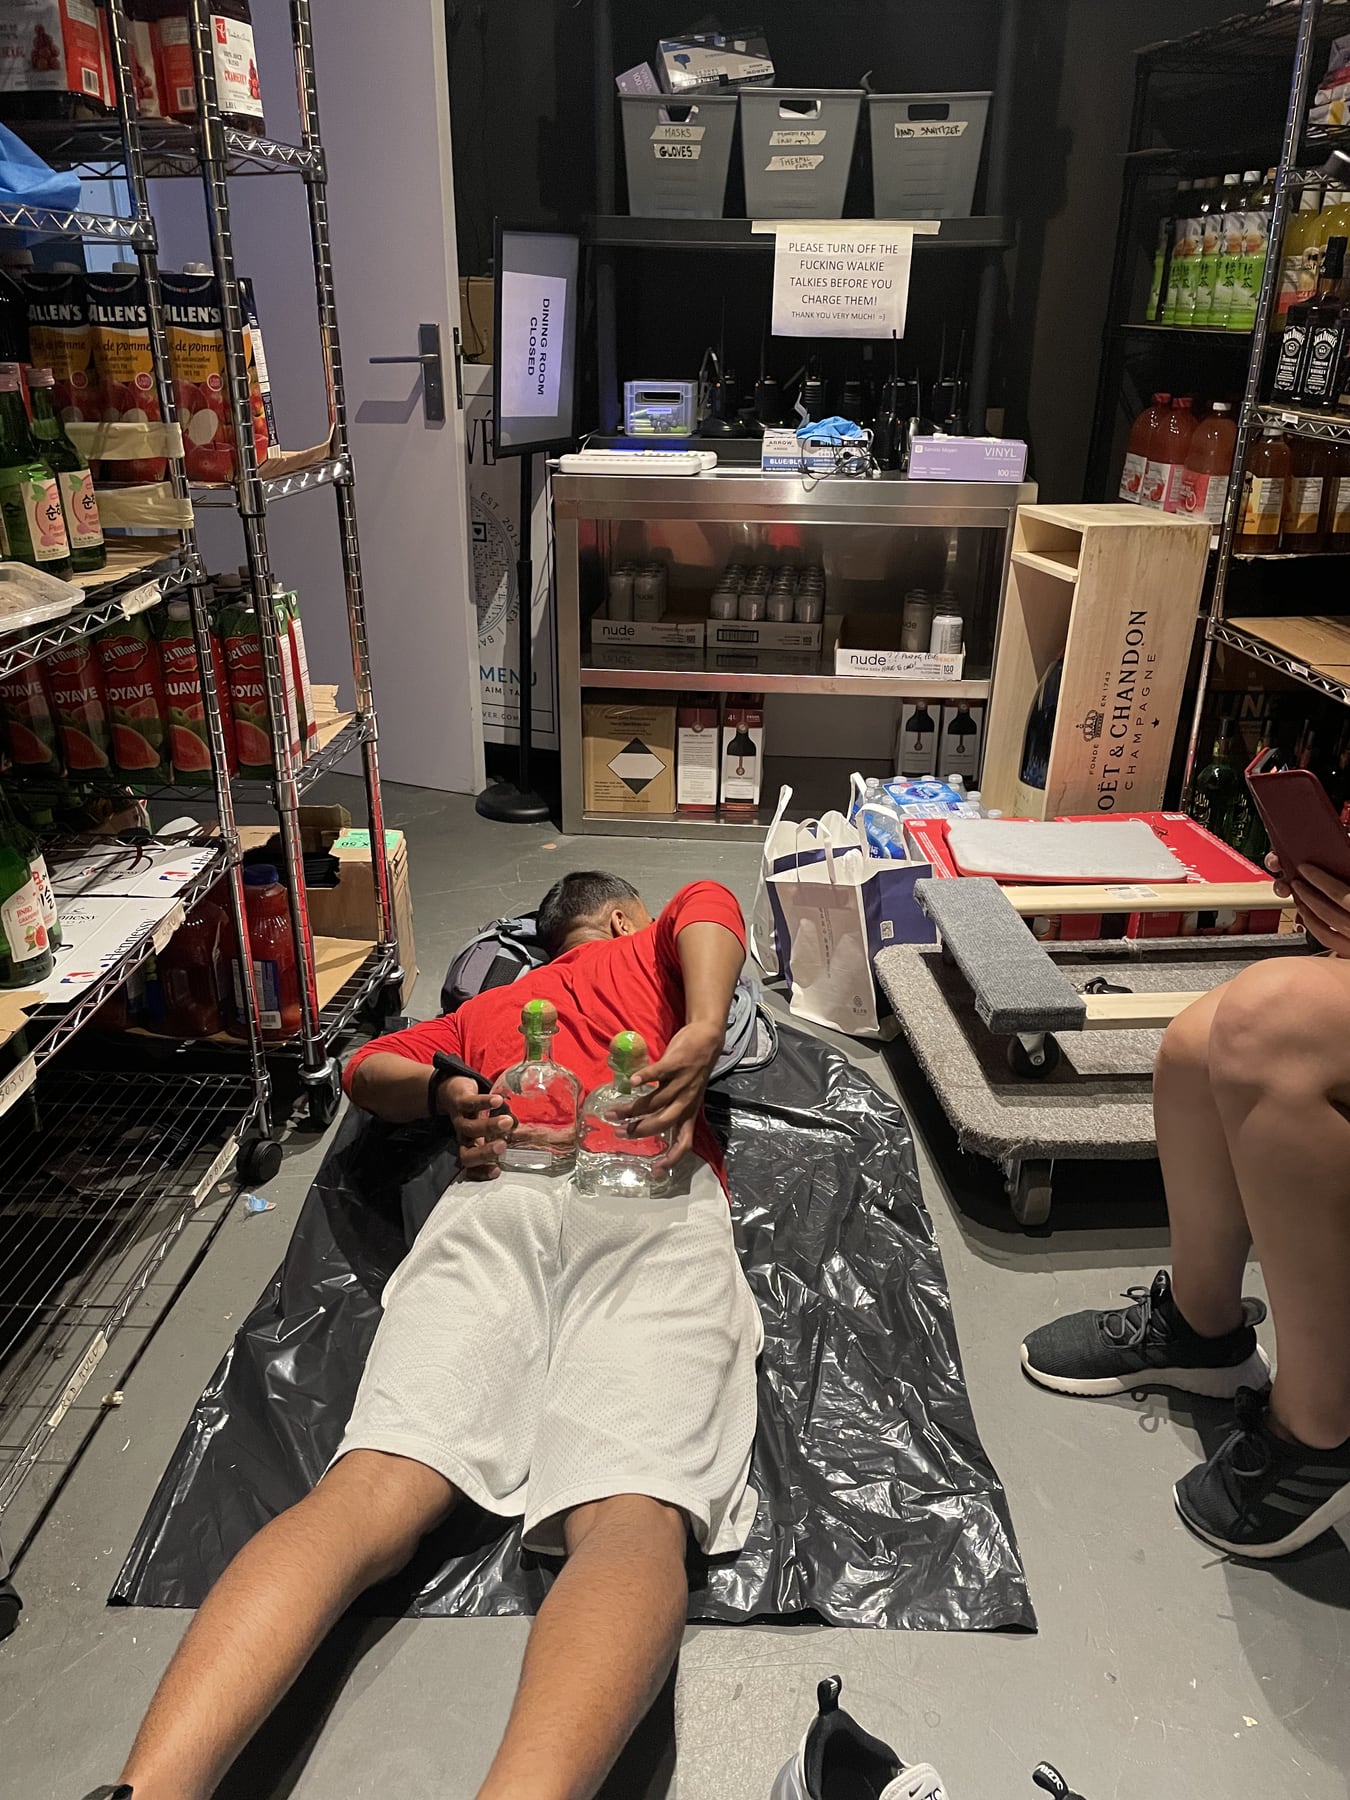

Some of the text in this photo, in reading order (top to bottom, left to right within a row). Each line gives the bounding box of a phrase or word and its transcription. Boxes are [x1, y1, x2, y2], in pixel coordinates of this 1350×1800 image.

[664, 127, 692, 138] MASKS
[659, 145, 693, 158] GLOVES
[788, 242, 899, 255] PLEASE TURN OFF THE
[800, 260, 885, 271] FUCKING WALKIE
[790, 277, 893, 289] TALKIES BEFORE YOU
[801, 294, 878, 306] CHARGE THEM!
[28, 304, 83, 321] ALLEN'S
[88, 305, 148, 322] ALLEN'S
[162, 304, 221, 323] ALLEN'S
[792, 311, 815, 319] THANK
[816, 311, 831, 319] YOU
[832, 312, 850, 320] VERY
[850, 312, 875, 320] MUCH!
[103, 338, 152, 356] de pomme
[175, 339, 225, 356] de pomme
[528, 317, 538, 376] CLOSED
[537, 298, 550, 395] DINING ROOM
[984, 447, 1017, 458] VINYL
[480, 491, 499, 511] EST
[602, 624, 635, 636] nude
[116, 642, 145, 657] Monte
[850, 653, 887, 666] nude
[0, 681, 43, 698] OYAVE
[1103, 671, 1111, 692] 1743
[55, 686, 98, 704] OYAVE
[1097, 609, 1148, 811] OËT & CHANDON
[1125, 653, 1157, 790] CHAMPAGNE
